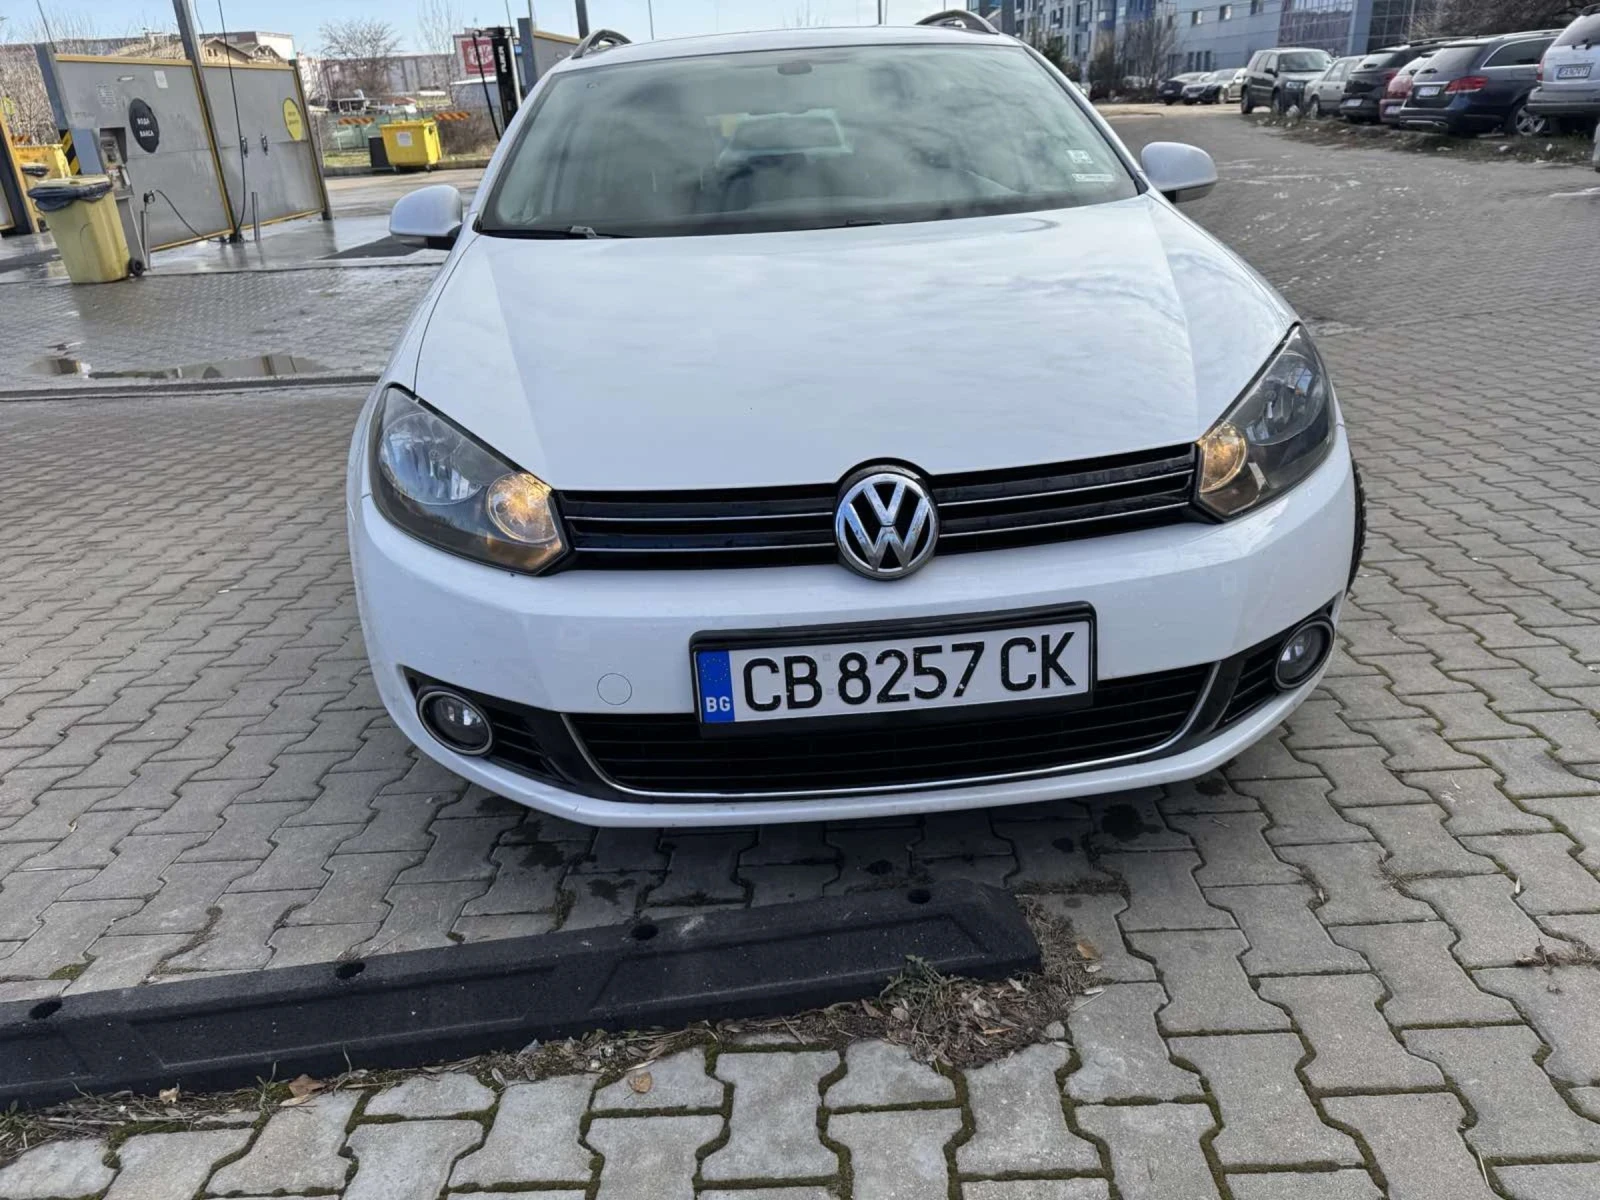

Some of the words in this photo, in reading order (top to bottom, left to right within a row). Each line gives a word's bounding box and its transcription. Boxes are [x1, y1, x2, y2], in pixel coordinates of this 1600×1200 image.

[742, 655, 823, 712] CB
[837, 641, 985, 706] 8257
[1000, 631, 1077, 692] CK
[705, 696, 731, 713] BG
